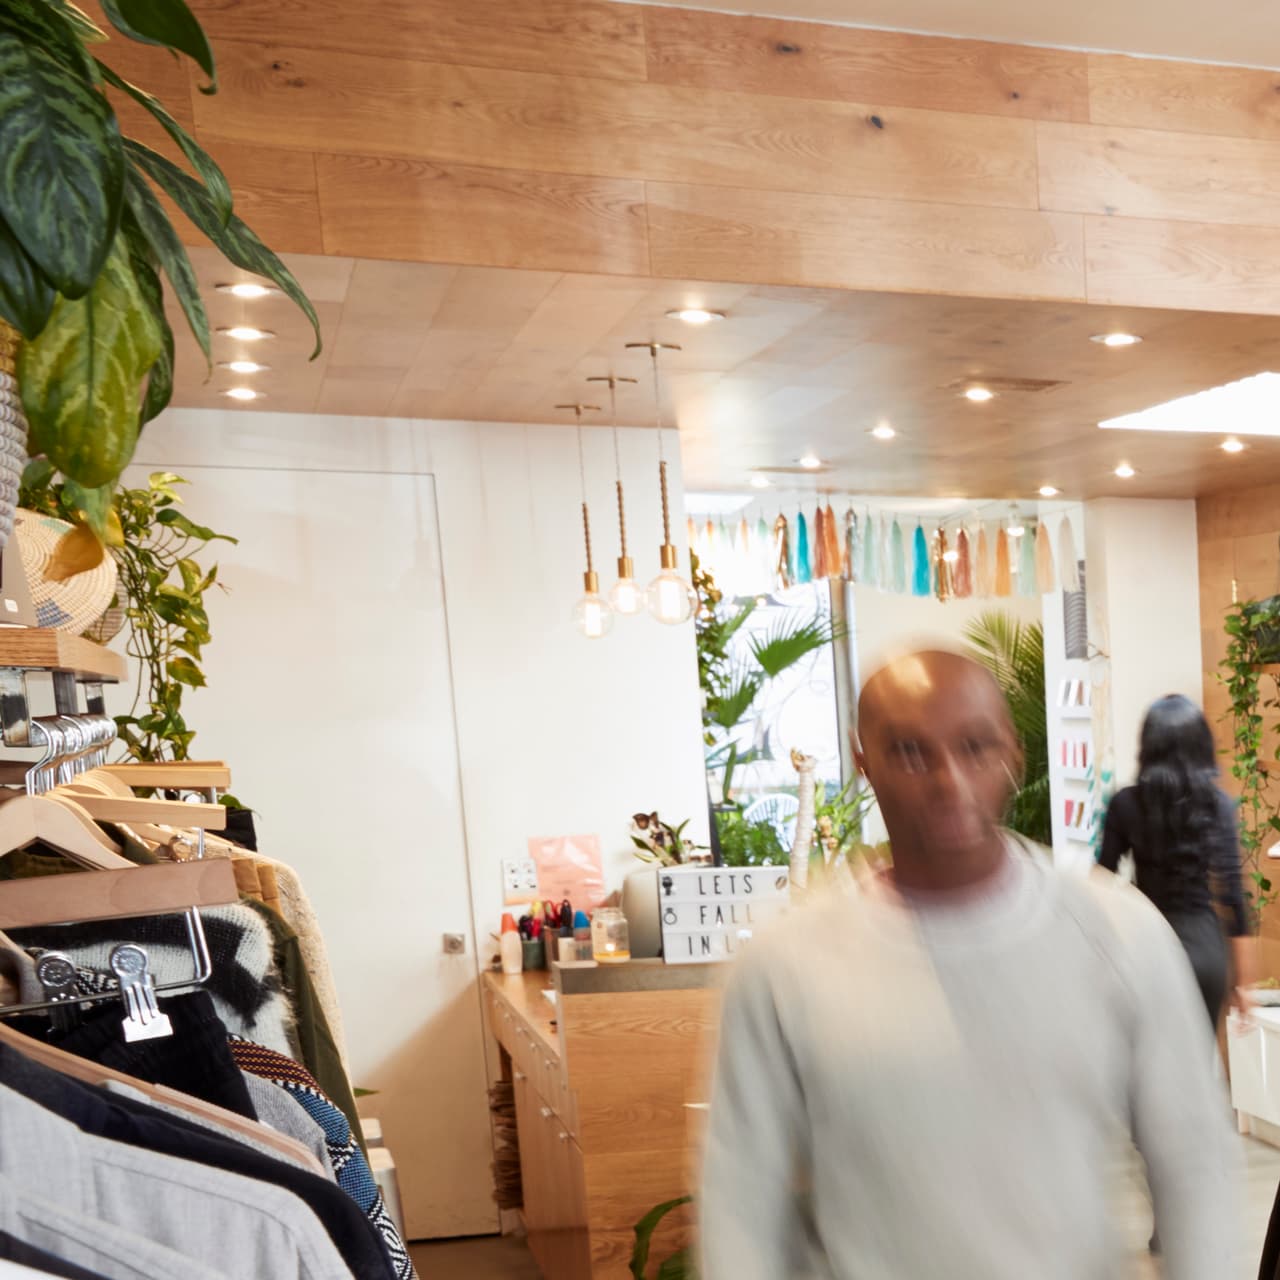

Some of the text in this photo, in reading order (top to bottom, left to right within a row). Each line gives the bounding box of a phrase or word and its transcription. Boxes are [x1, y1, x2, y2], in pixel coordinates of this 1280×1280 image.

[698, 874, 753, 896] LETS
[699, 904, 754, 925] FALL
[688, 935, 711, 956] IN
